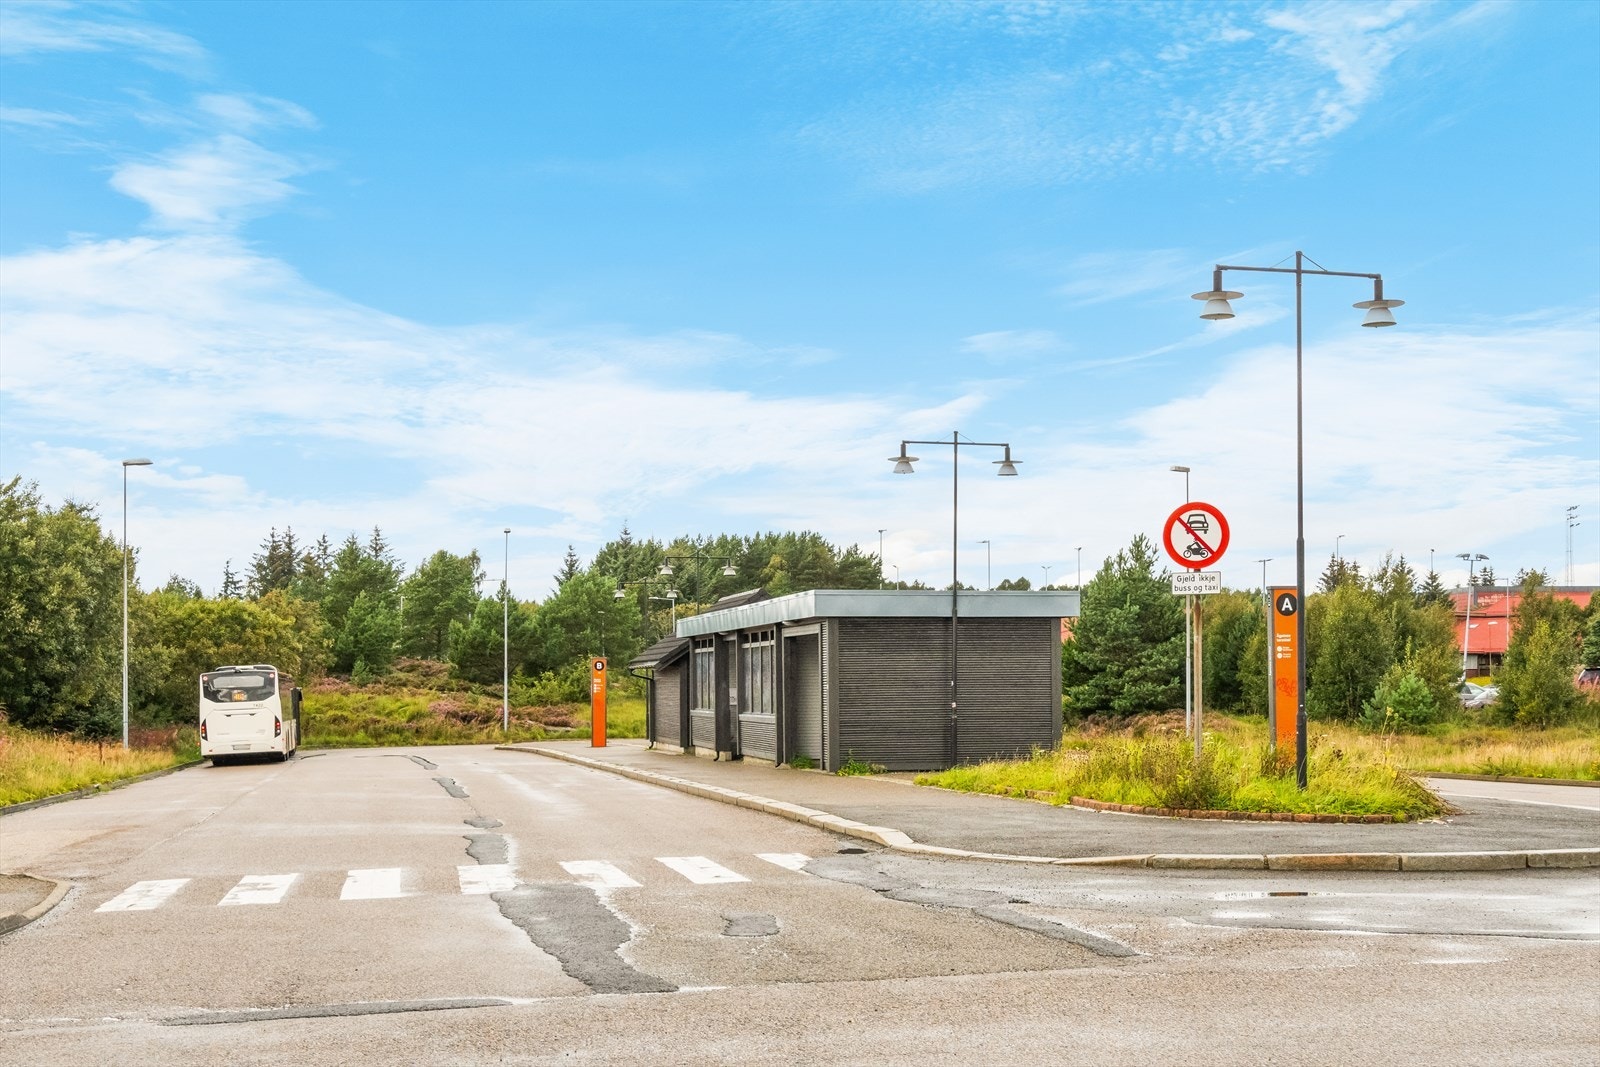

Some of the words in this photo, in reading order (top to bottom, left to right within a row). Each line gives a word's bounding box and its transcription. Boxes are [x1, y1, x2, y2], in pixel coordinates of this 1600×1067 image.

[1177, 574, 1195, 583] Gjeld
[1198, 574, 1216, 583] ikkje
[1282, 598, 1293, 611] A
